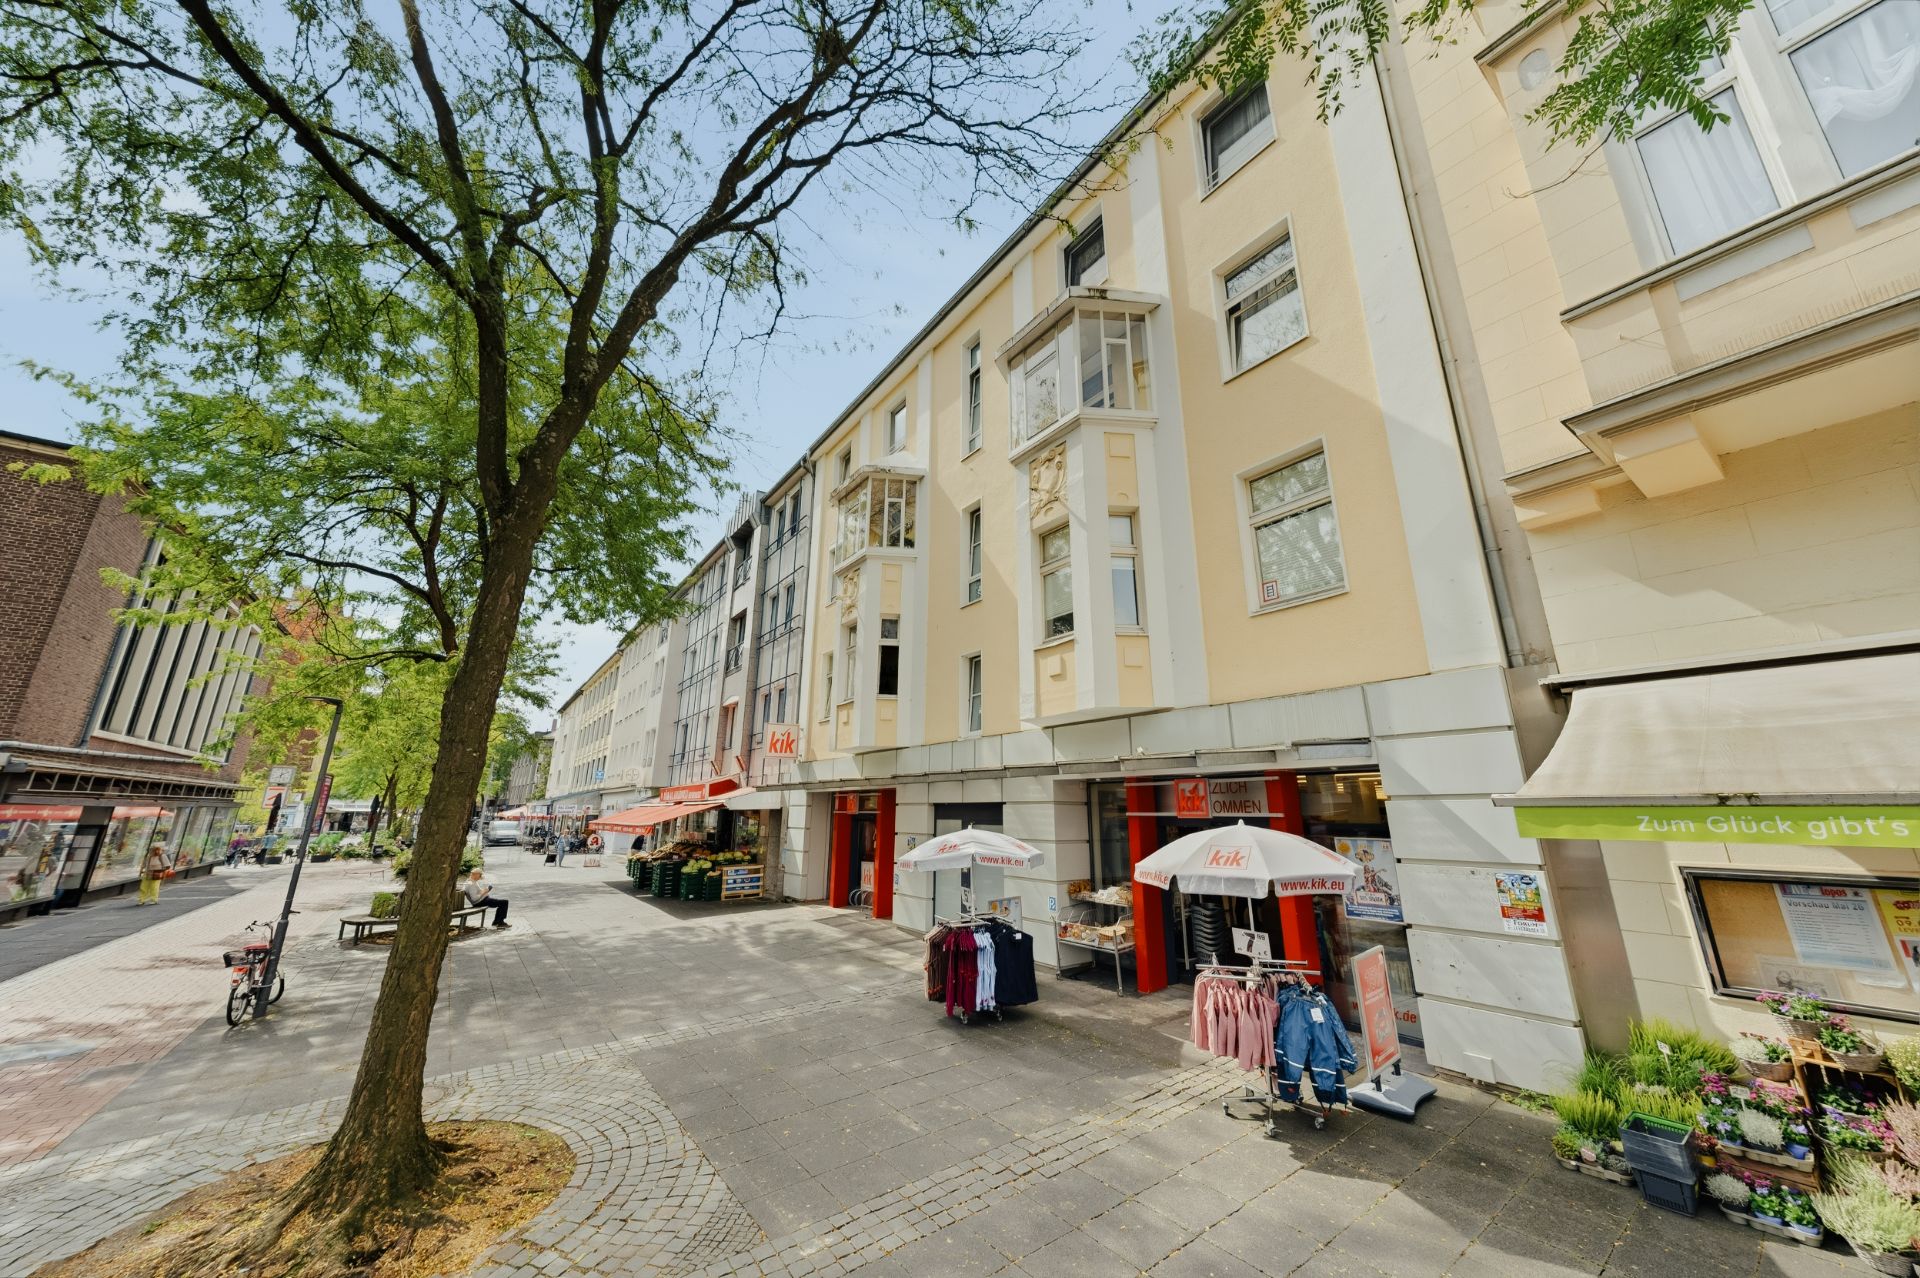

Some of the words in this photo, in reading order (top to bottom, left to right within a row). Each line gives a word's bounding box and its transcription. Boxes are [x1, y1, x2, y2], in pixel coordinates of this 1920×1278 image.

[769, 730, 795, 753] kik
[1208, 781, 1248, 794] ZLICH
[1636, 815, 1695, 833] Zum
[1706, 815, 1795, 834] Glück
[1807, 816, 1909, 840] gibt's
[979, 856, 1023, 867] www.kik.eu
[1209, 849, 1245, 867] kik
[1280, 878, 1345, 891] www.kik.eu
